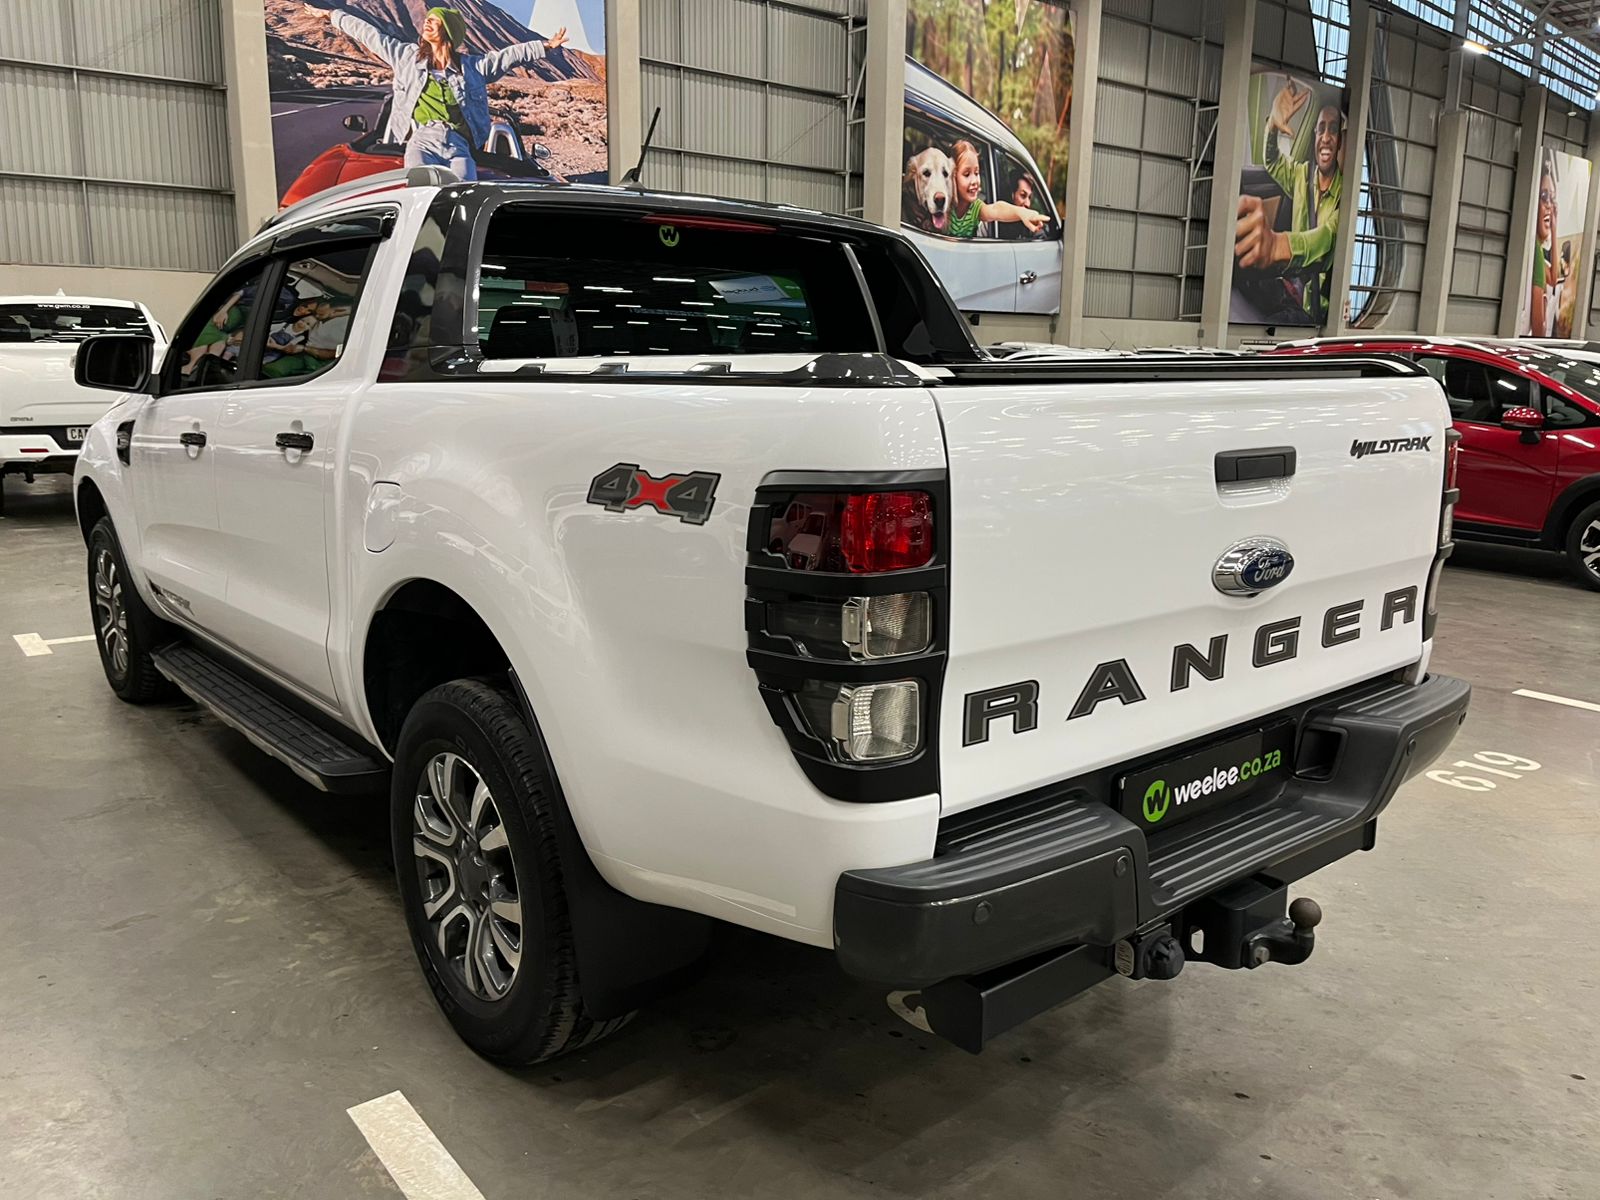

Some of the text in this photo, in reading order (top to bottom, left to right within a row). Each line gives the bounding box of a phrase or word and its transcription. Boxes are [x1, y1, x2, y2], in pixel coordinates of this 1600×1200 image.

[1349, 435, 1432, 460] WILDTRAK
[1254, 555, 1287, 583] Ford
[962, 584, 1418, 748] RANGER
[1174, 749, 1282, 806] weelee.co.za
[1425, 750, 1542, 792] 619
